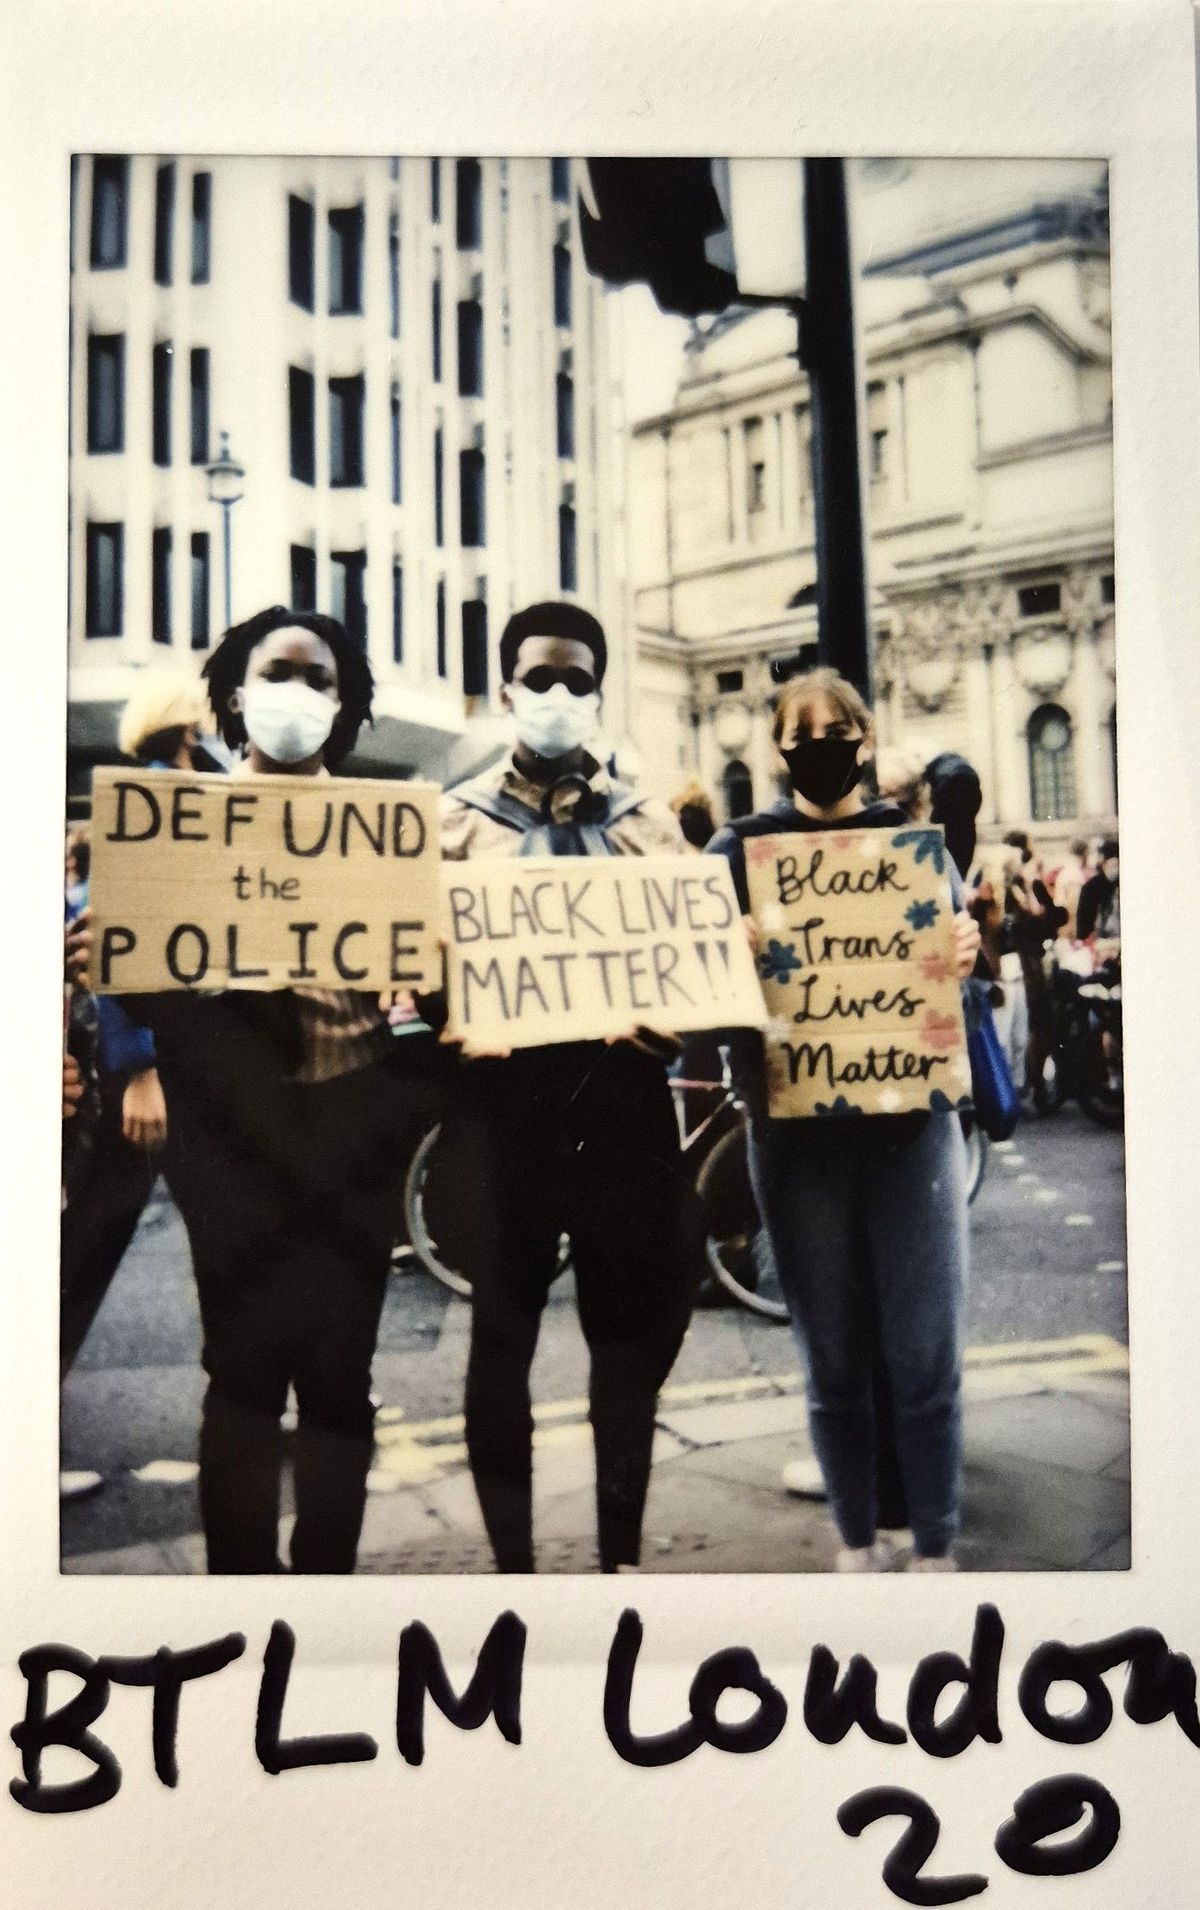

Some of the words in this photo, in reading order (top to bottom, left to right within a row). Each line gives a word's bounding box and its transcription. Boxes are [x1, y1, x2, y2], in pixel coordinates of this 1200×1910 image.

[105, 782, 426, 858] DEFUND
[232, 865, 301, 901] the
[776, 849, 909, 905] Black
[449, 879, 605, 943] BLACK
[614, 876, 734, 934] LIVES
[790, 917, 915, 966] Trans
[100, 921, 425, 985] POLICE
[462, 941, 739, 1023] MATTER!!
[794, 974, 926, 1023] Lives
[780, 1042, 949, 1088] Matter
[9, 1609, 527, 1814] BTLM
[603, 1601, 1200, 1767] London
[837, 1772, 1121, 1906] 20
